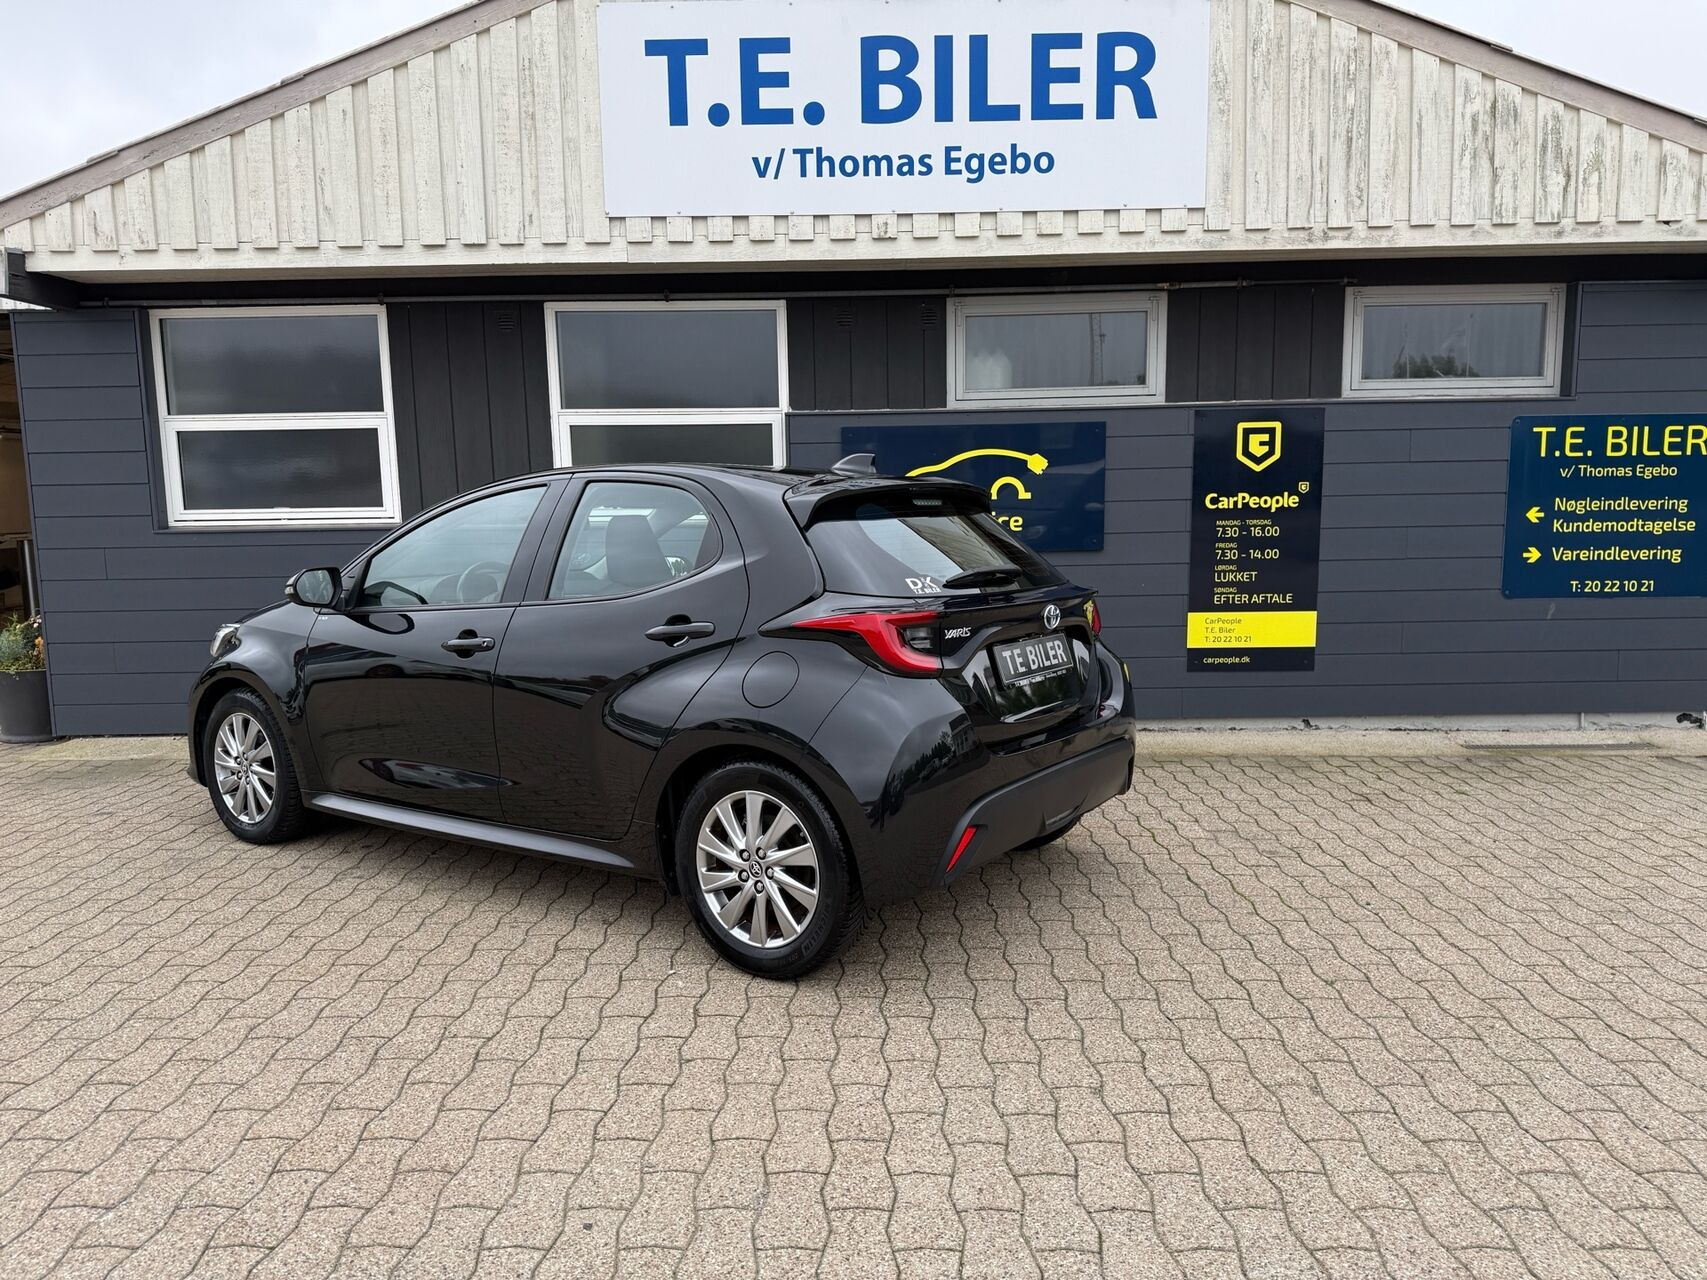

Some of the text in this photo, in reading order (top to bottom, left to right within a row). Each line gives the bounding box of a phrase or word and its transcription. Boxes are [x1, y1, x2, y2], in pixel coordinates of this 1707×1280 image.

[644, 31, 1158, 127] T.E. BILER
[751, 143, 1055, 184] v/ Thomas Egebo
[1532, 425, 1707, 457] T.E. BILER
[1560, 464, 1678, 479] v/ Thomas Egebo
[1205, 491, 1300, 513] CarPeople
[1554, 496, 1688, 514] Nøgleindlevering
[1215, 527, 1239, 538] 7.30
[1250, 526, 1280, 537] 16.00
[1552, 517, 1696, 535] Kundemodtagelse
[1215, 550, 1238, 560] 7.30
[1249, 549, 1280, 559] 14.00
[1551, 545, 1682, 564] Vareindlevering
[1214, 571, 1258, 582] LUKKET
[1570, 580, 1654, 592] T: 20 22 10 21
[1213, 593, 1293, 605] EFTER AFTALE
[1204, 617, 1242, 625] CarPeople
[944, 627, 972, 640] YARIS
[1026, 640, 1067, 670] BILER
[1203, 656, 1251, 665] carpeople.dk
